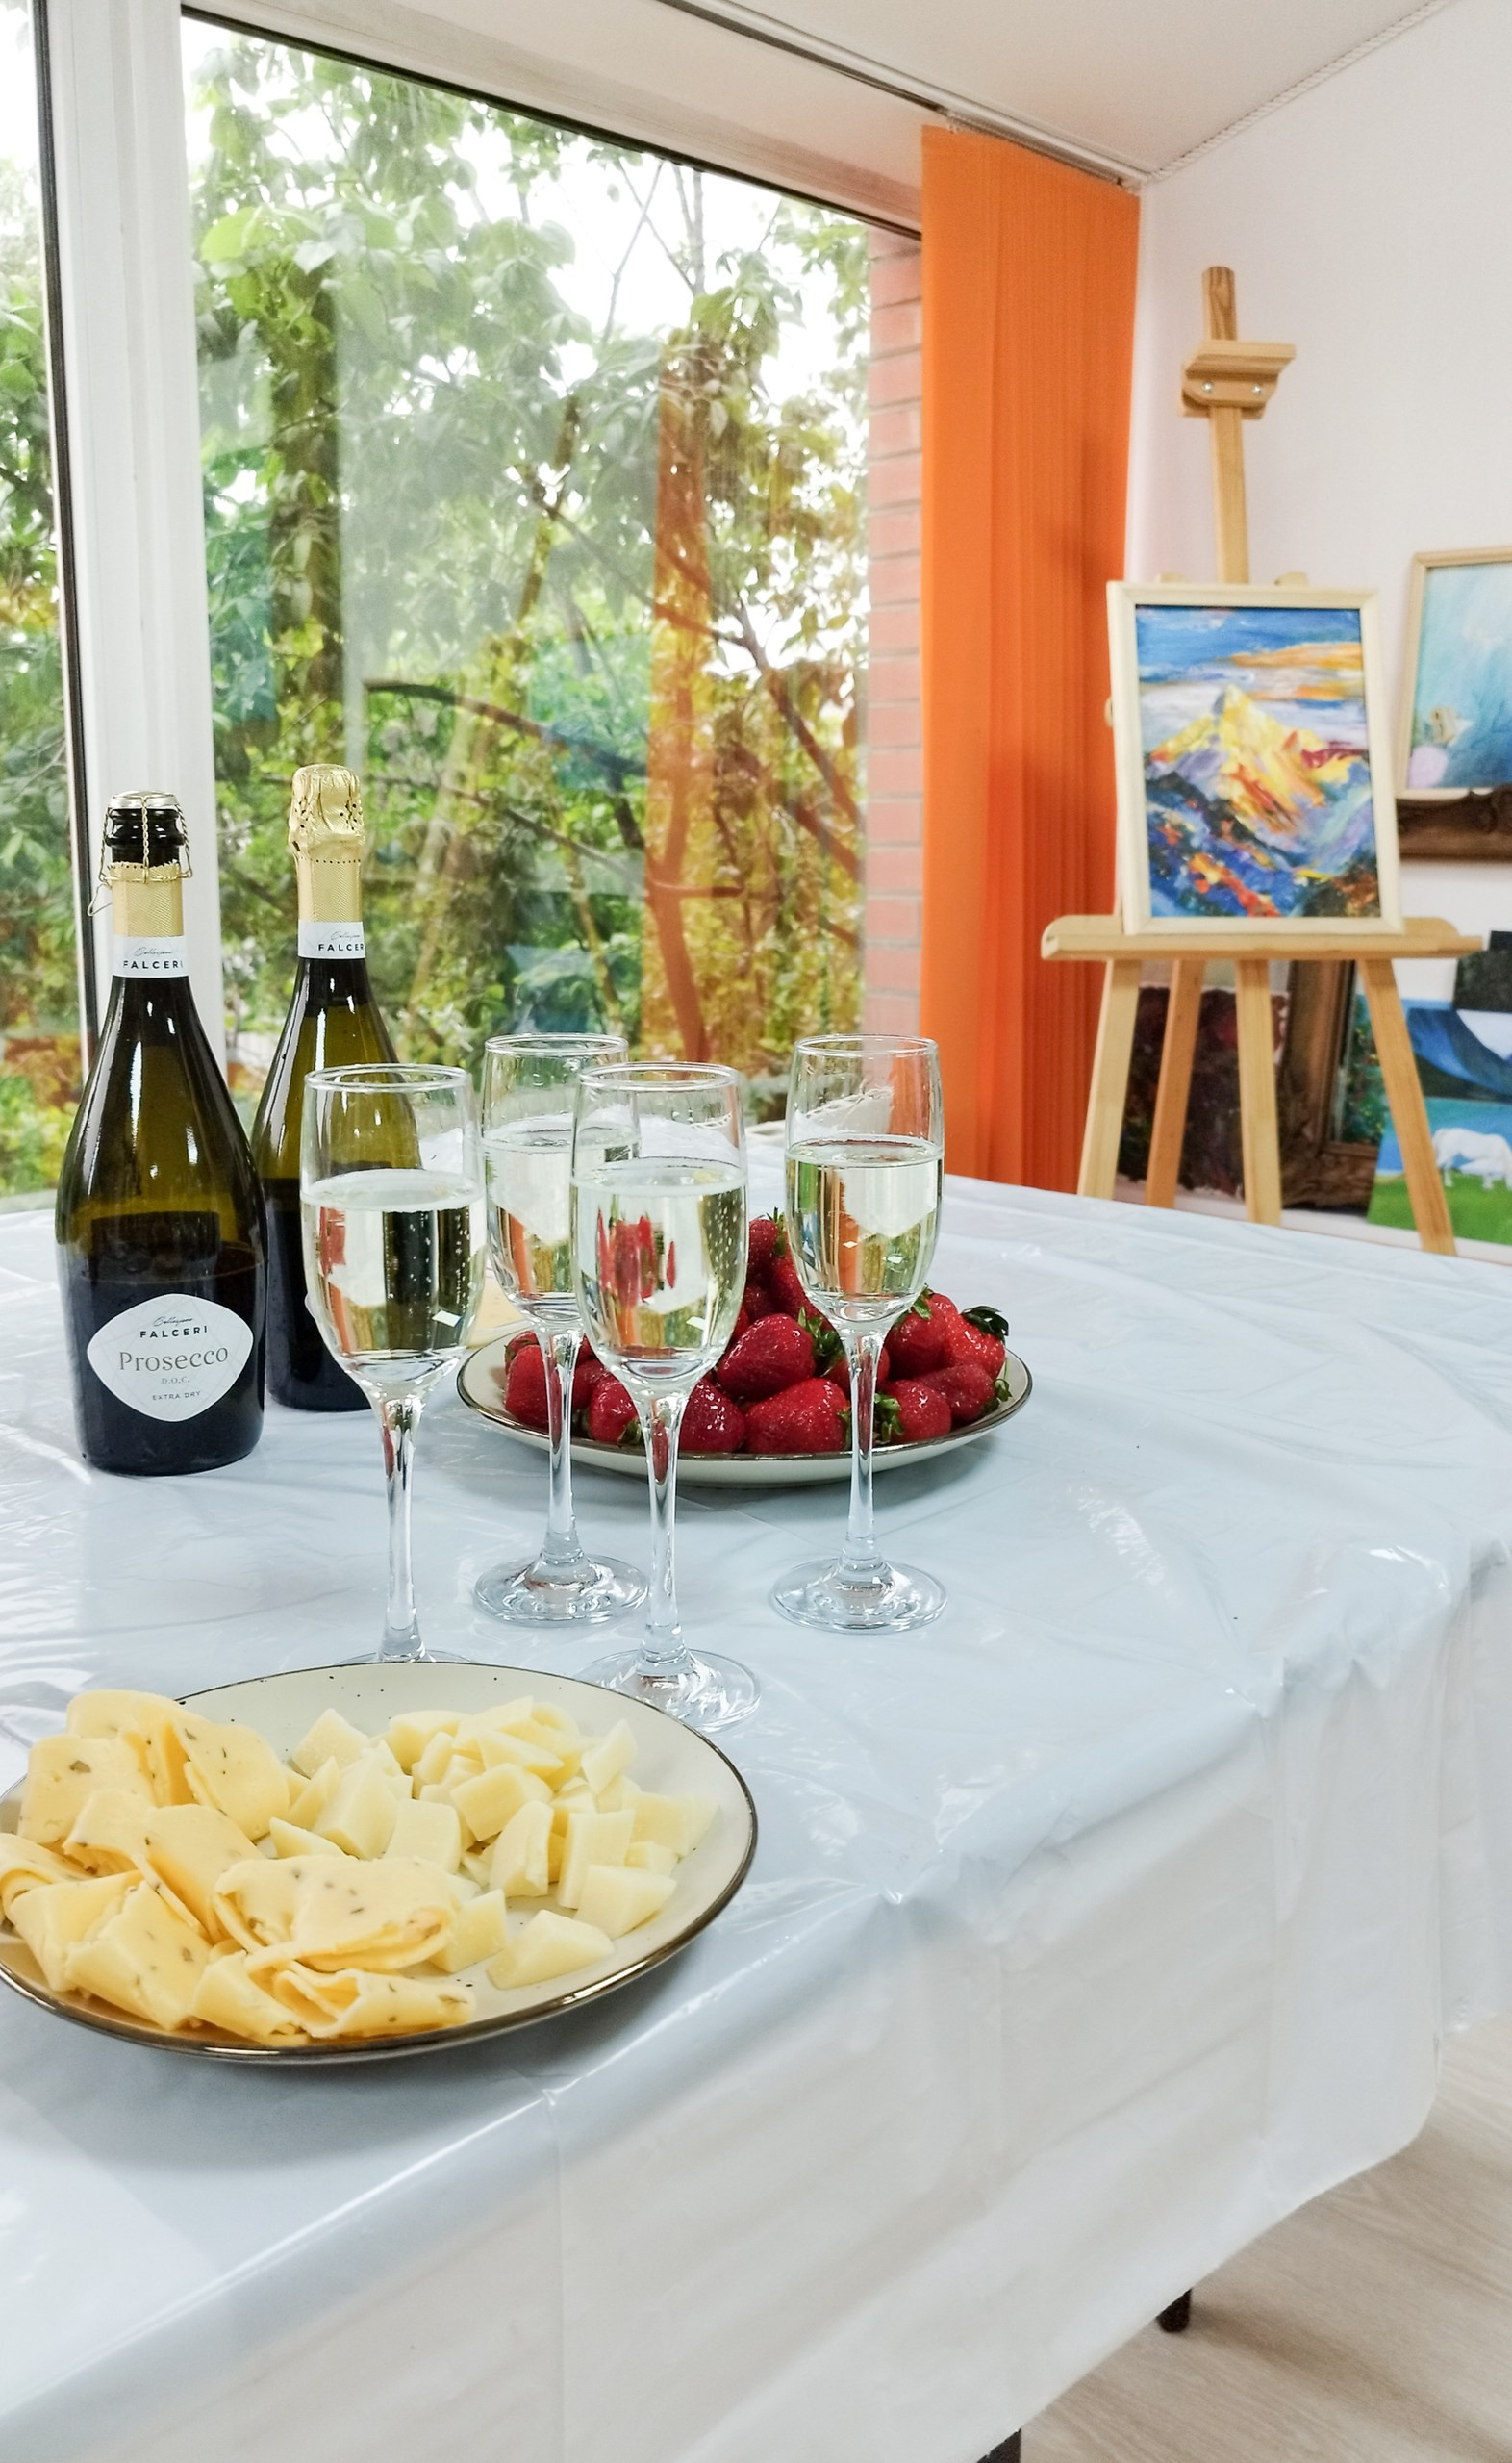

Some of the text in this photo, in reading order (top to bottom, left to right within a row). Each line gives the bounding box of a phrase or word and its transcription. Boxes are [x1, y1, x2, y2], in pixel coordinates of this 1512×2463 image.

[123, 960, 183, 969] FALCERI
[139, 1325, 208, 1338] FALCERI
[119, 1347, 229, 1372] Prosecco
[161, 1376, 190, 1385] D.O.C.
